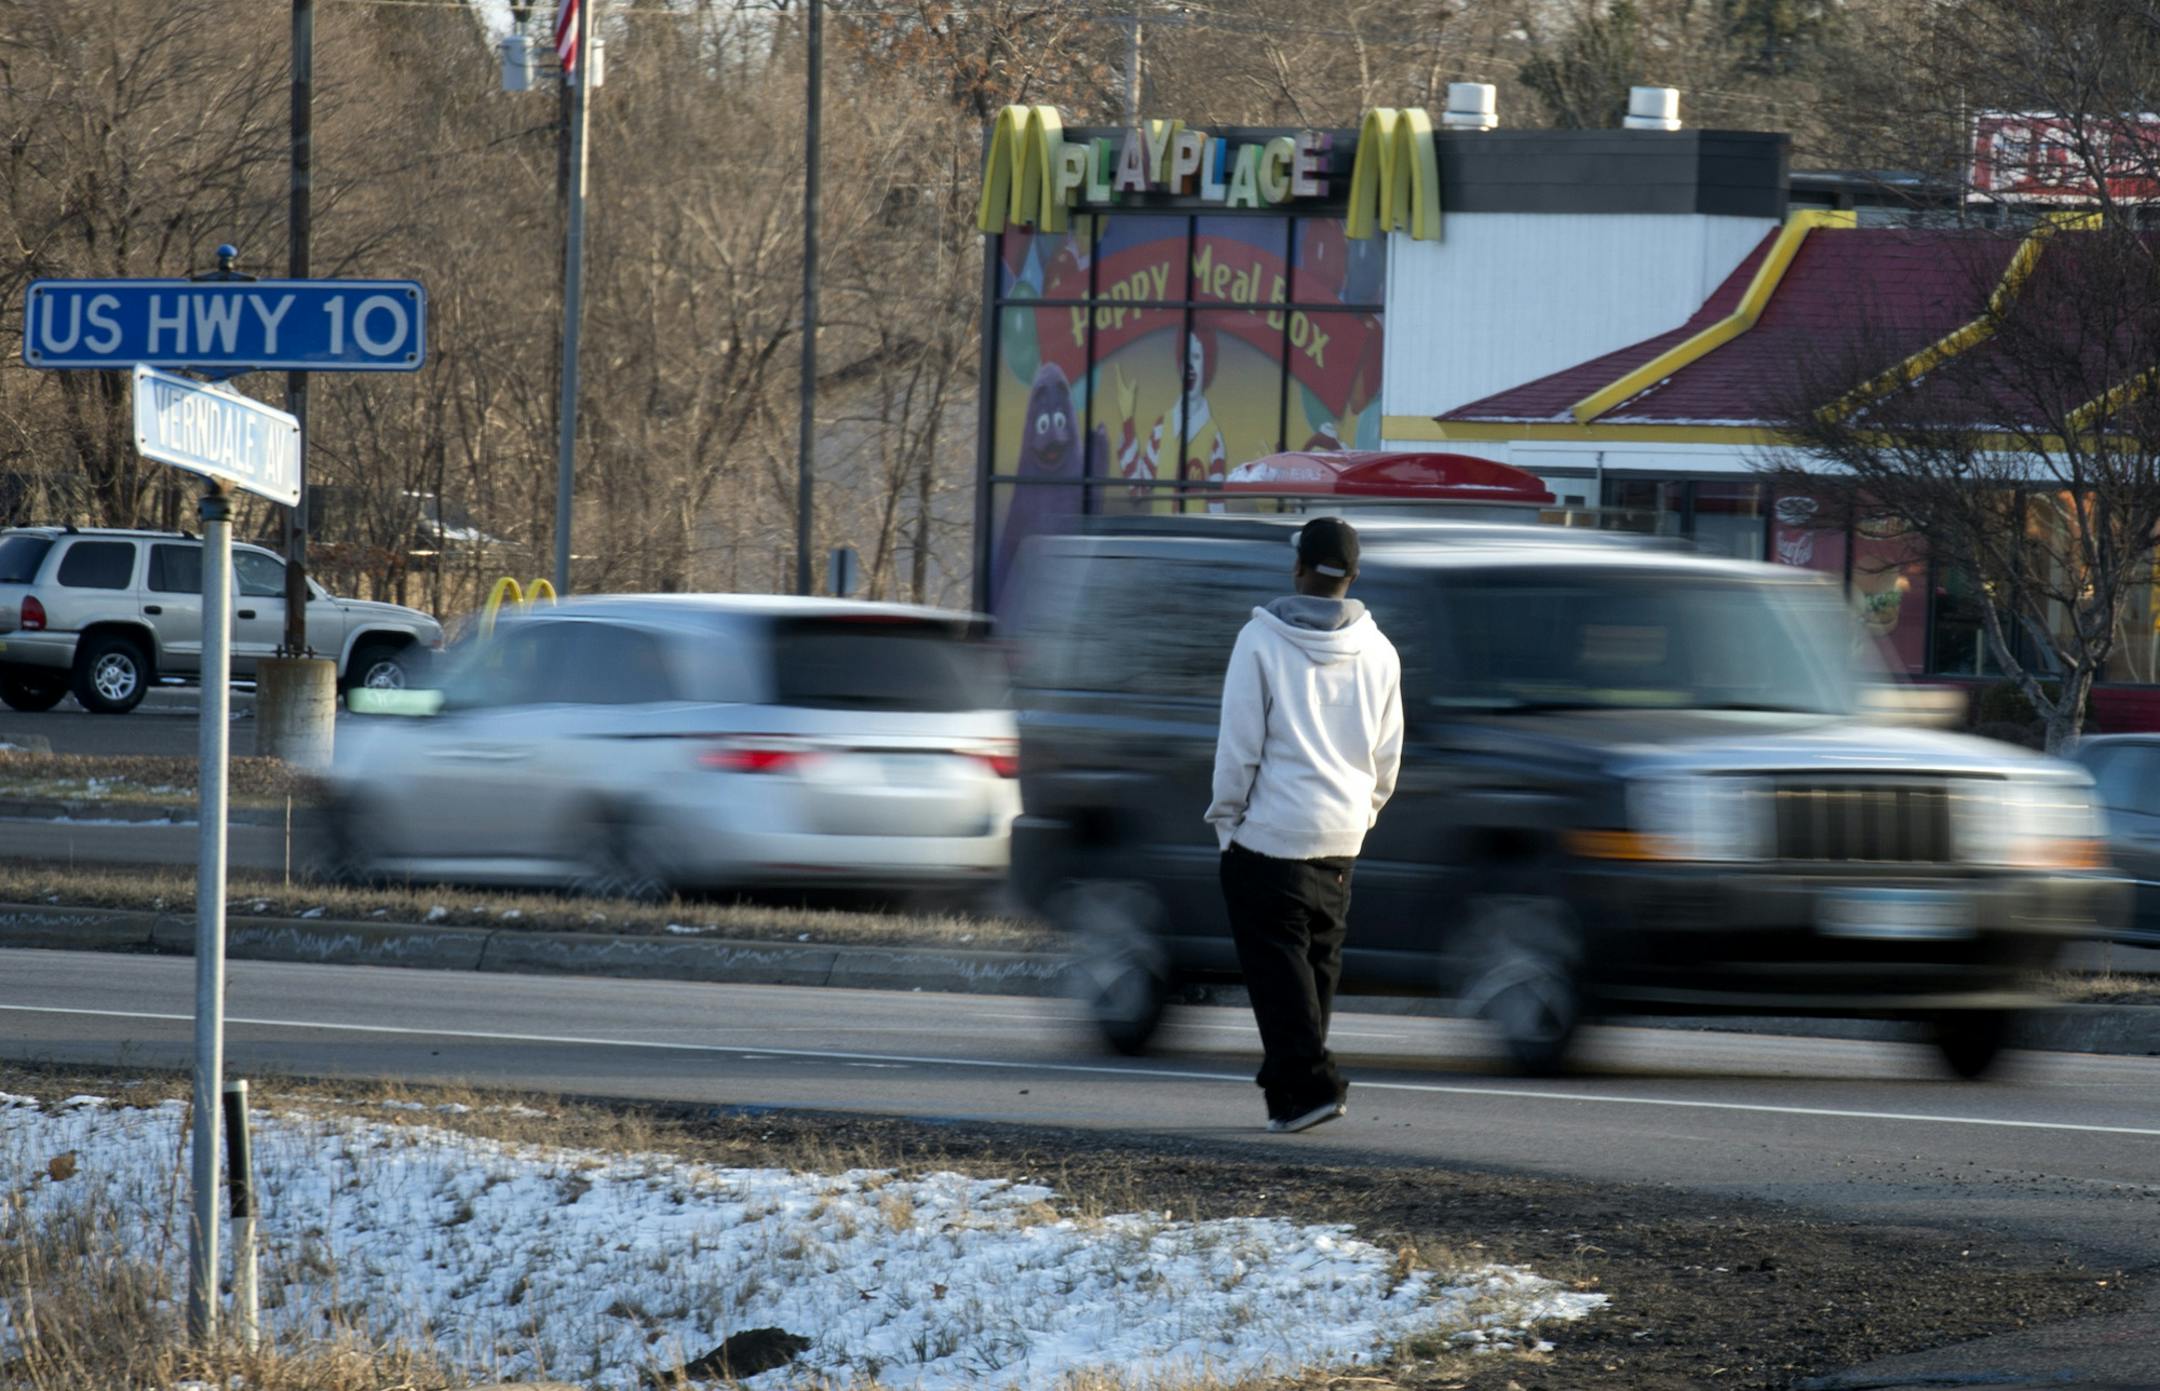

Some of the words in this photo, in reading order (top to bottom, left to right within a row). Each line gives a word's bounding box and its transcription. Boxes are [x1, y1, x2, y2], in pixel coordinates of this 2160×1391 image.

[1055, 118, 1332, 208] PLAYPLACE
[1192, 245, 1262, 315] Meal
[40, 293, 122, 354] US
[147, 293, 296, 354] HWY
[323, 294, 409, 356] 10
[154, 384, 257, 475] VERNDALE
[264, 424, 287, 484] AV
